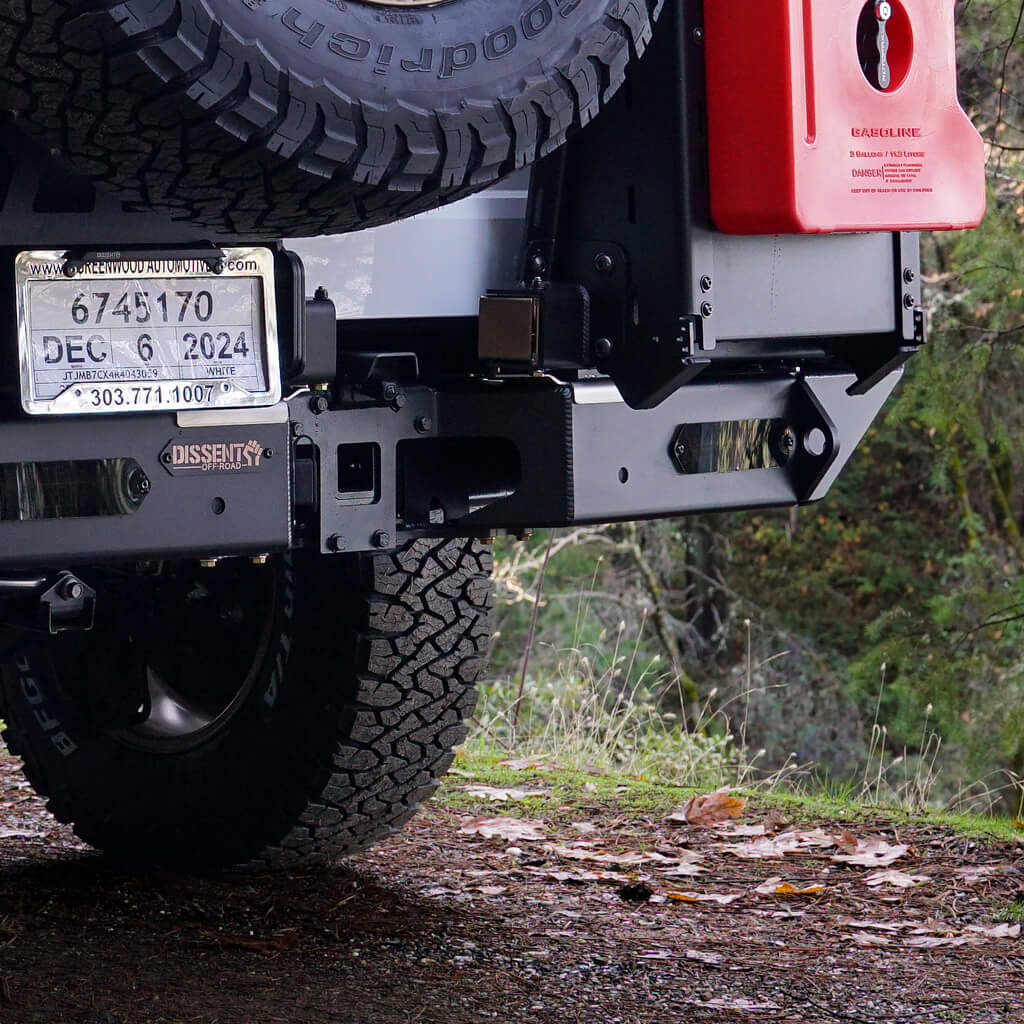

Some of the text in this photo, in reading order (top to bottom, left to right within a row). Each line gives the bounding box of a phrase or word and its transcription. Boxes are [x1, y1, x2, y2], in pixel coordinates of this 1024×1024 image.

[851, 127, 921, 138] GASOLINE
[852, 168, 882, 178] DANGER
[71, 290, 213, 325] 6745170
[43, 332, 249, 364] DEC 6 2024
[207, 366, 236, 375] WHITE
[91, 384, 214, 407] 303.771.1007
[172, 442, 245, 464] DISSENT
[201, 462, 242, 471] OFF-ROAD
